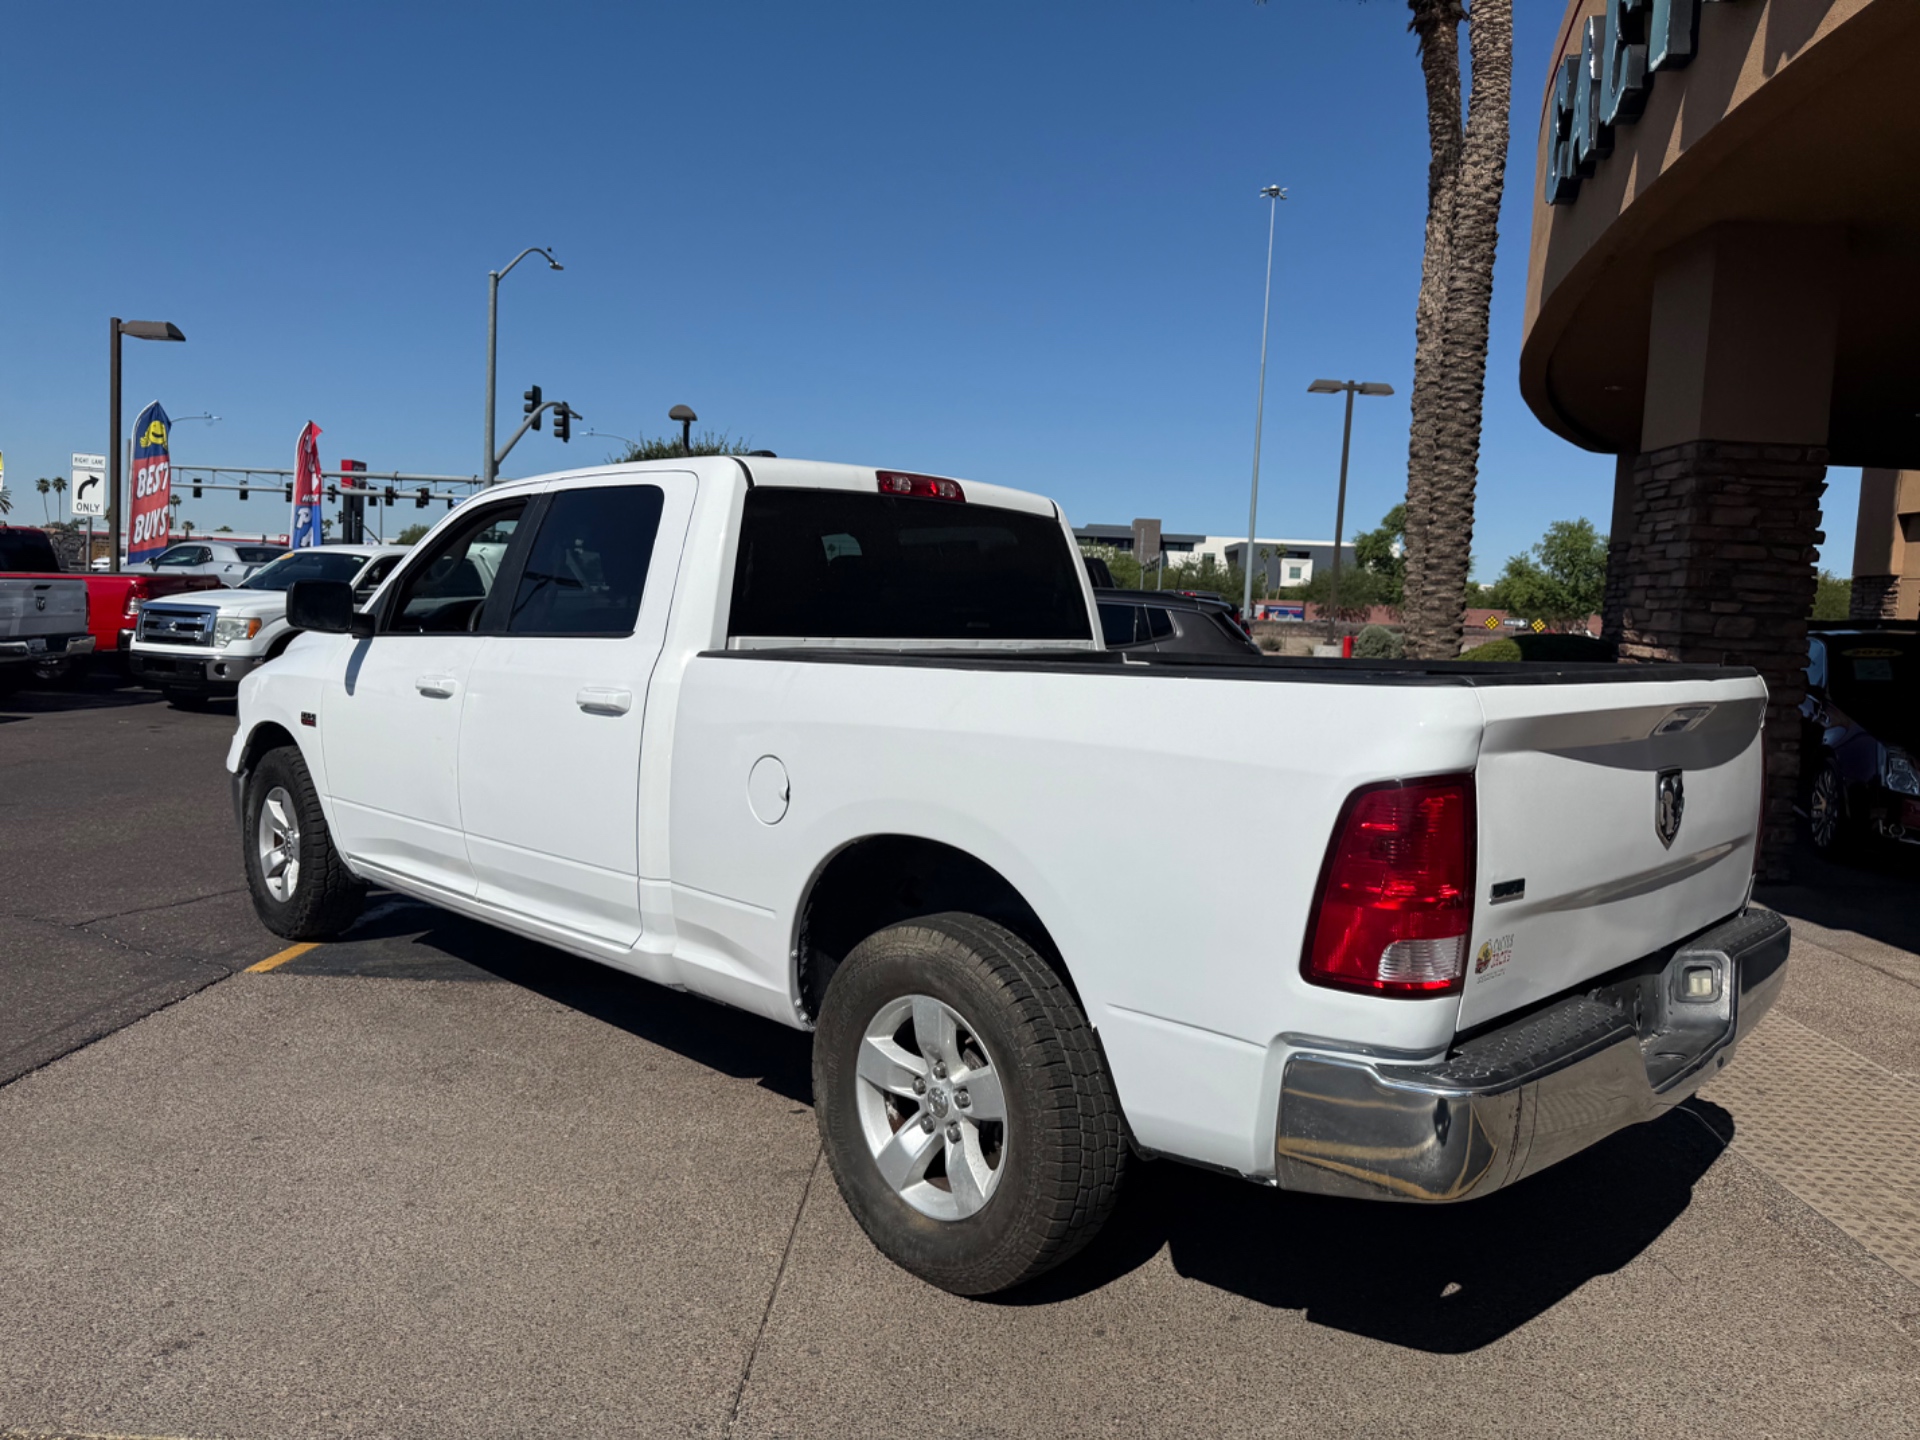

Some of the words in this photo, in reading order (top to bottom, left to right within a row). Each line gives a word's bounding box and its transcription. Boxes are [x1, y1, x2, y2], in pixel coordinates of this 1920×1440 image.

[91, 458, 104, 466] LANE
[136, 462, 169, 499] BEST
[76, 502, 101, 513] ONLY
[133, 505, 169, 544] BUYS
